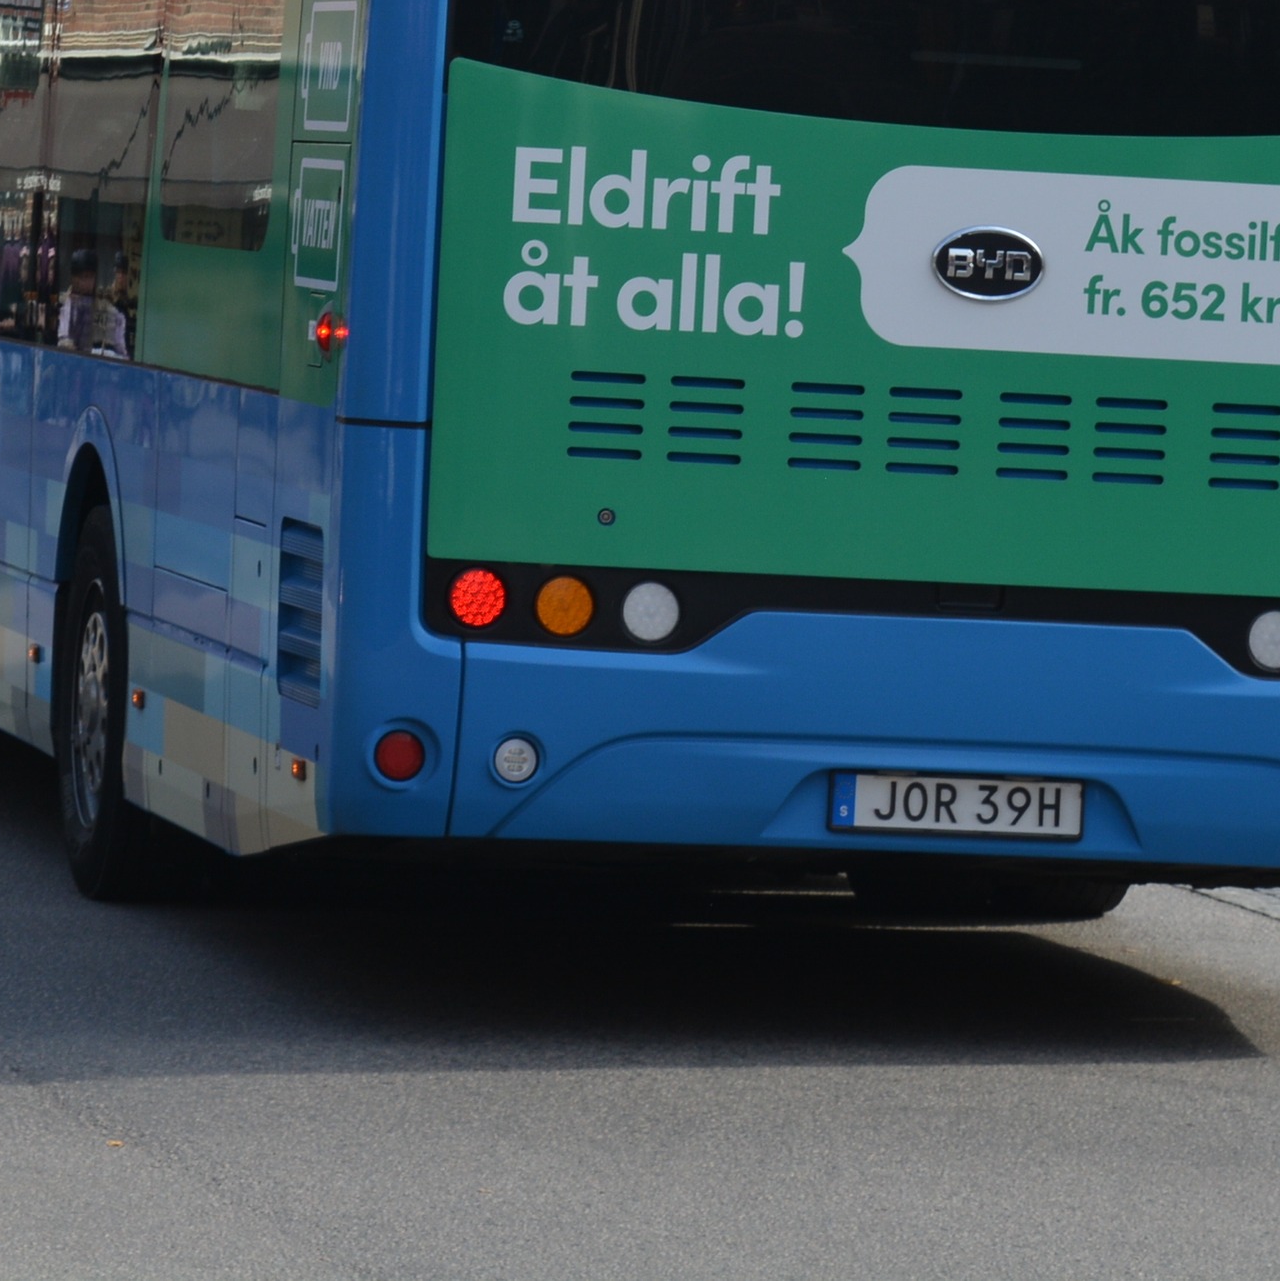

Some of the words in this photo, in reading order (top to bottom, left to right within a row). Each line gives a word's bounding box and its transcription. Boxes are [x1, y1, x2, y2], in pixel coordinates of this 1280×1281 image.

[318, 41, 342, 90] VIND
[512, 146, 781, 235] Eldrift
[302, 198, 337, 250] VATTEN
[1084, 199, 1144, 255] Åk
[503, 239, 599, 327] åt
[617, 252, 806, 338] alla!
[946, 248, 1031, 281] BYD
[1083, 275, 1127, 317] fr.
[1141, 280, 1225, 322] 652
[839, 805, 848, 817] S
[874, 781, 958, 824] JOR
[976, 785, 1062, 828] 39H
